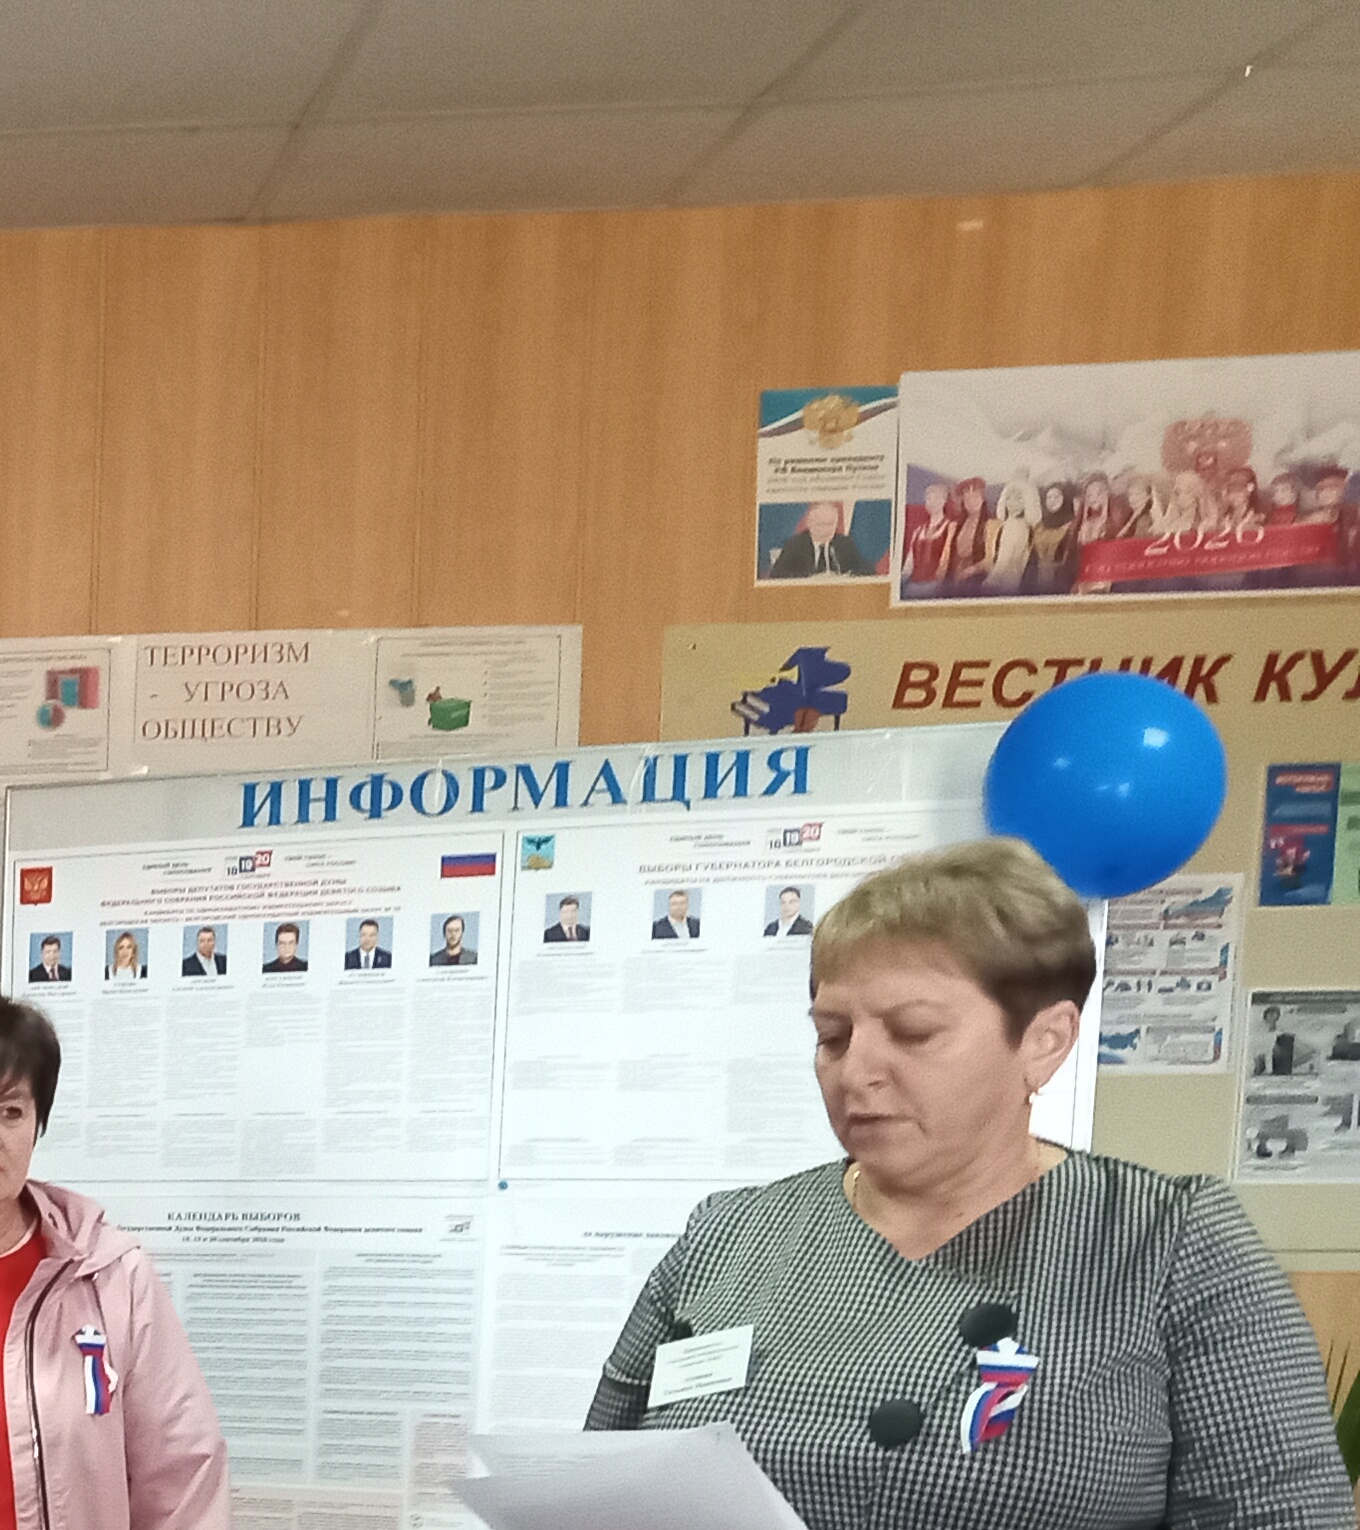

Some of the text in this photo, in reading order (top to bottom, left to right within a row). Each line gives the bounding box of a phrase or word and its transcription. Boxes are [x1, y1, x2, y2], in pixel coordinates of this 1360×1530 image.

[1143, 510, 1265, 557] 2026
[143, 641, 310, 667] ТЕРРОРИЗМ
[1252, 647, 1360, 705] КУ
[184, 679, 289, 703] УГРОЗА
[141, 714, 304, 743] ОБЩЕСТВУ
[236, 744, 813, 829] ИНФОРМАЦИЯ
[255, 853, 270, 866] 20
[167, 1212, 301, 1222] КАЛЕНДАРЬ ВЫБОРОВ
